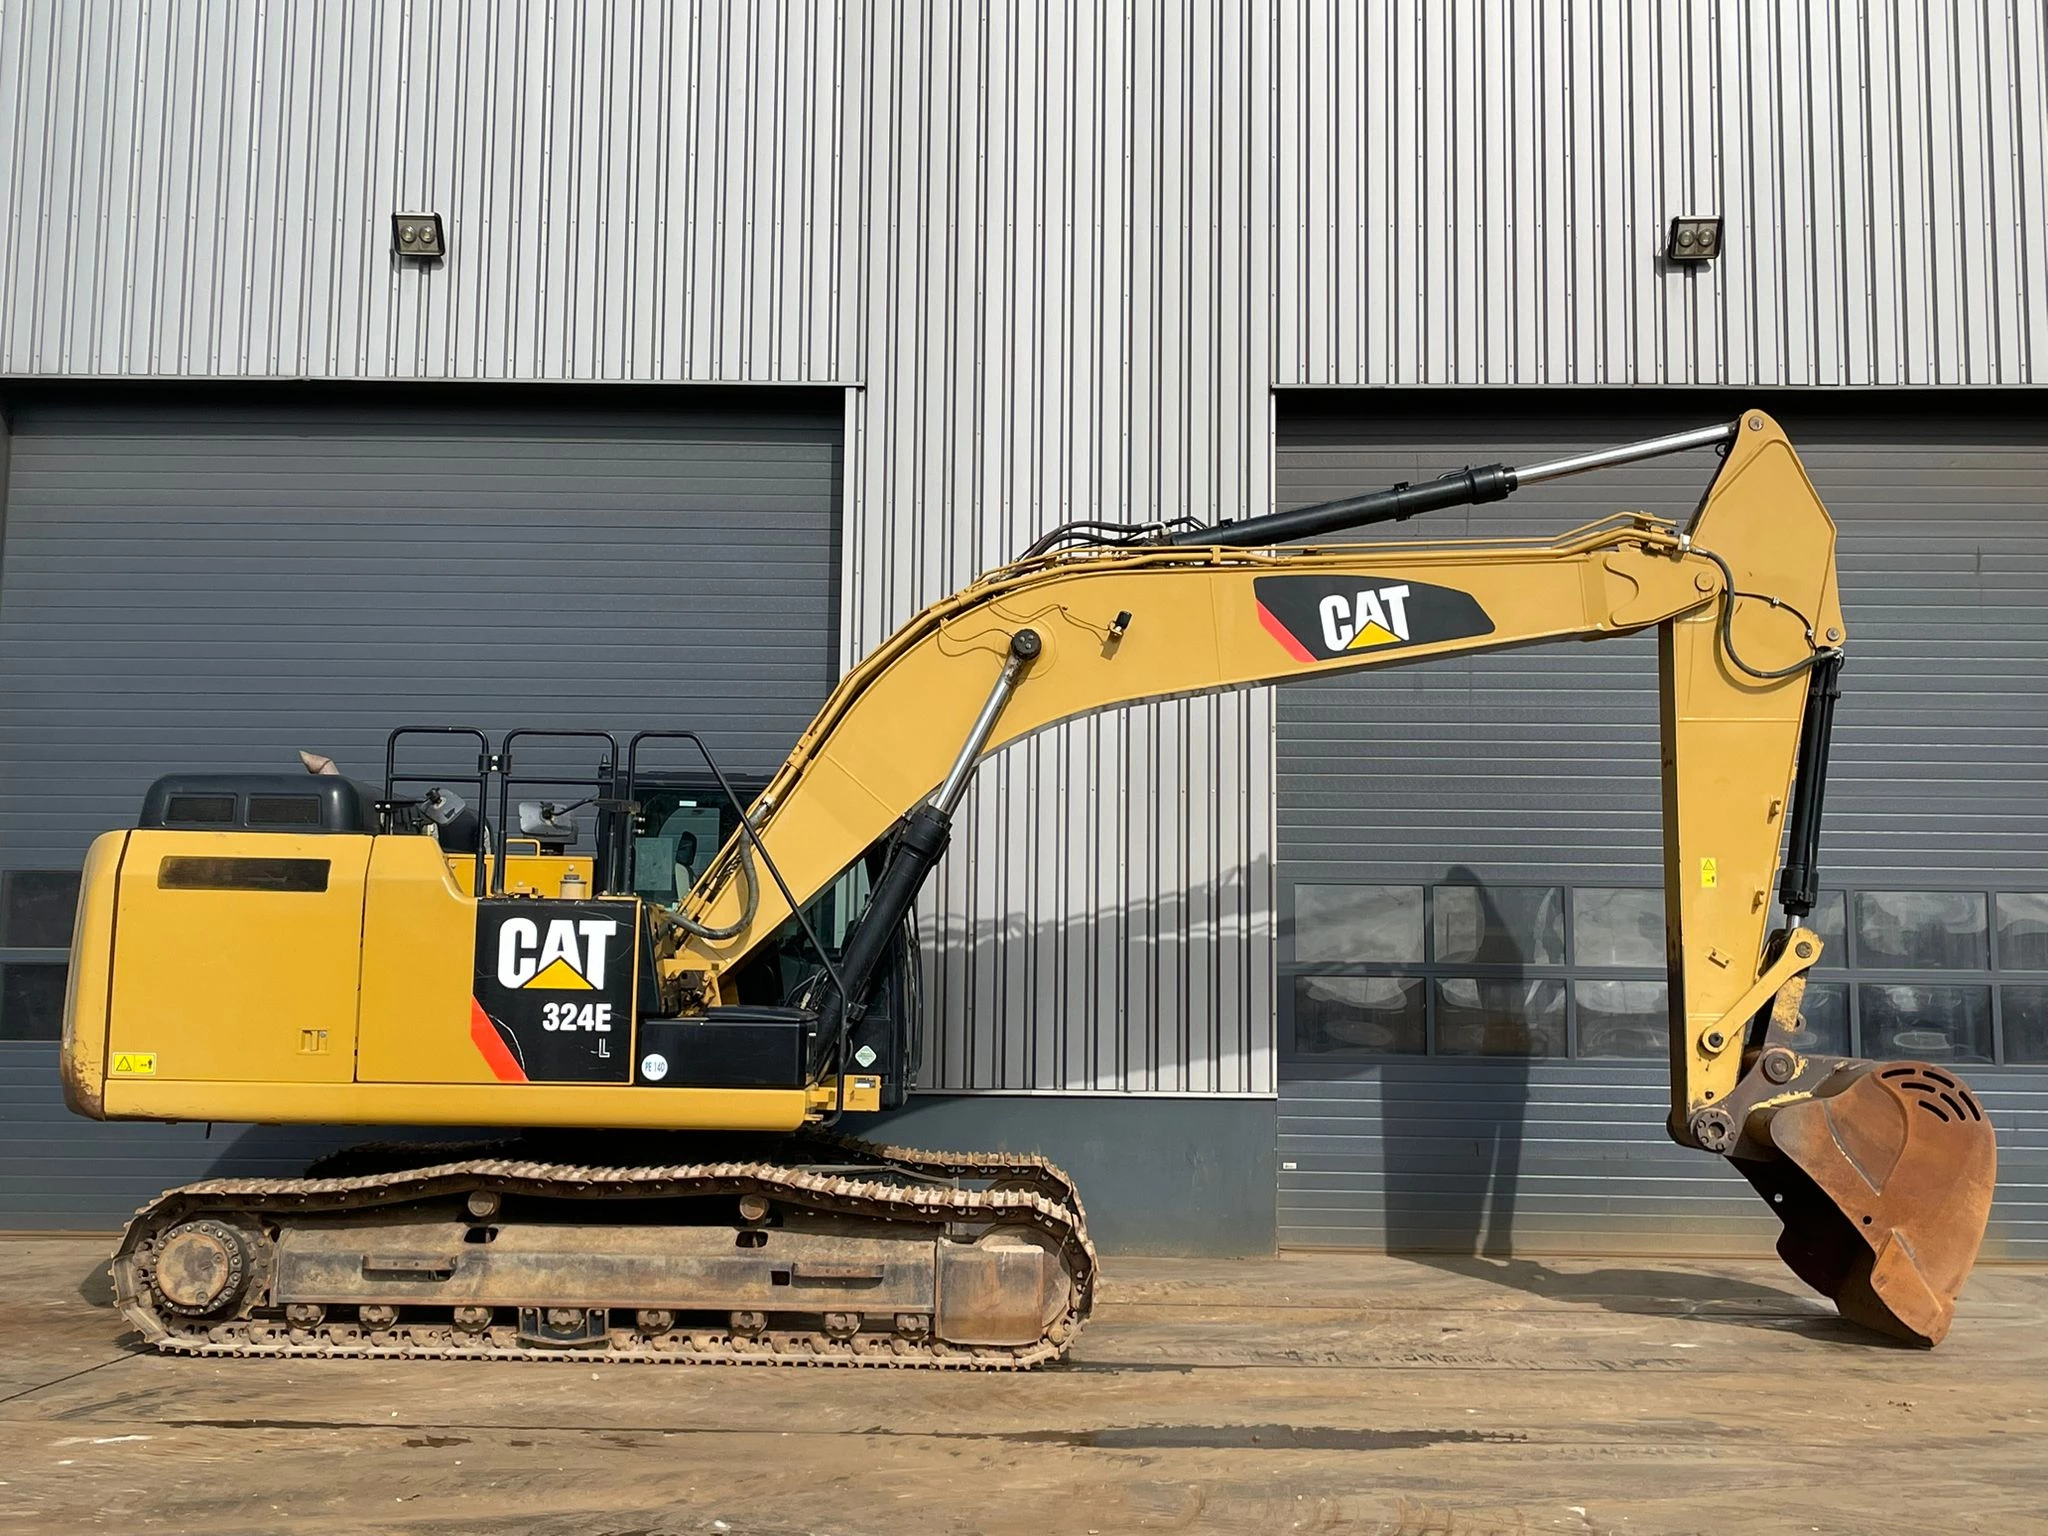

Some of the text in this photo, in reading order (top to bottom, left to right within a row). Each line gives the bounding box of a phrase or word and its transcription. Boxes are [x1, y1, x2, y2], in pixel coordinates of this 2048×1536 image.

[1319, 584, 1410, 652] CAT
[497, 917, 616, 990] CAT
[542, 1002, 611, 1032] 324E
[645, 1061, 652, 1072] PE
